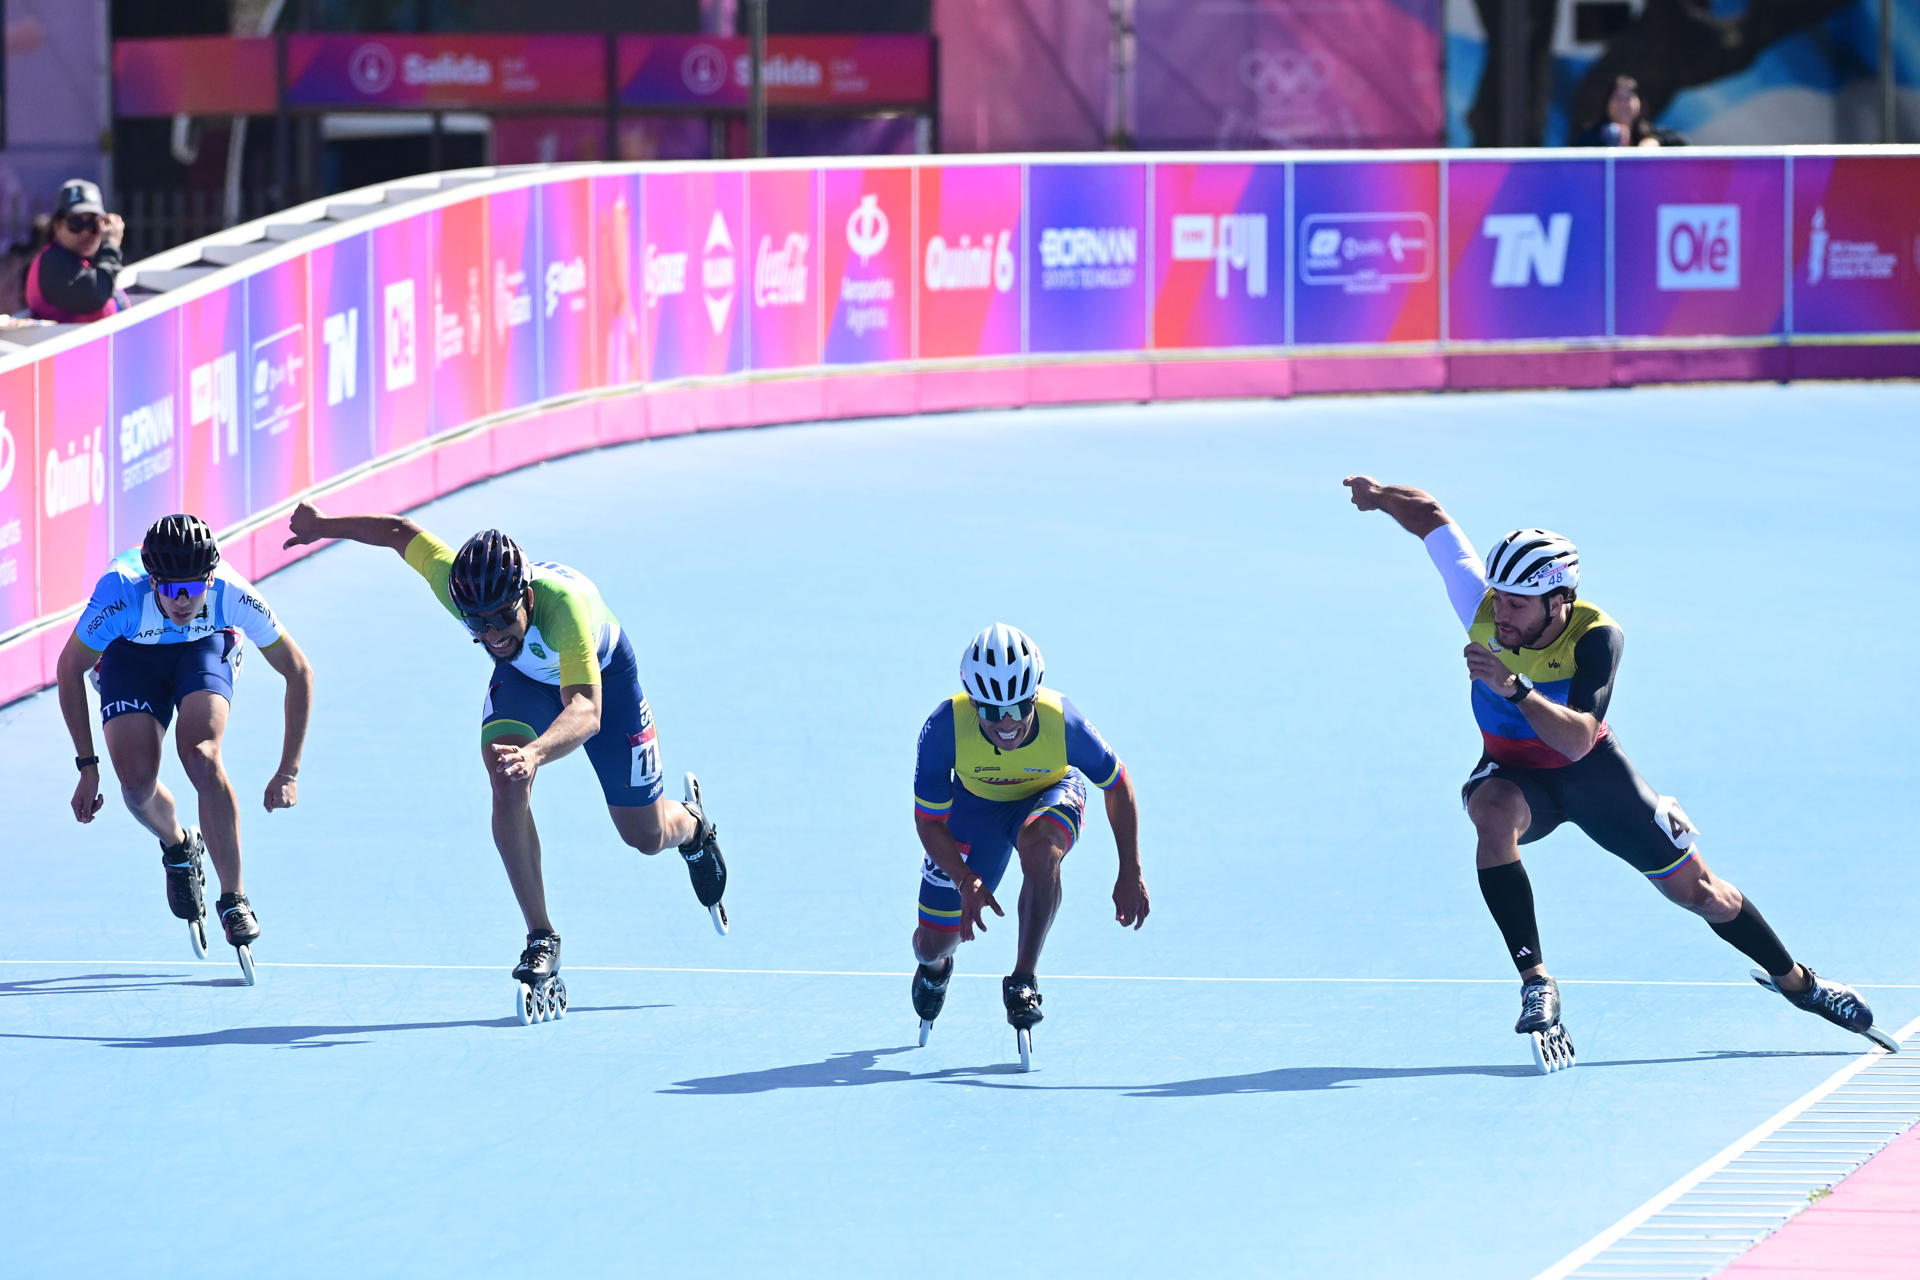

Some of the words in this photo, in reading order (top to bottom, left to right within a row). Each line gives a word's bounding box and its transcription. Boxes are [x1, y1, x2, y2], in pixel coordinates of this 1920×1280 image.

[403, 53, 491, 85] Salida
[925, 235, 993, 292] Quini
[994, 229, 1015, 293] 6
[1483, 212, 1573, 286] TN
[1668, 219, 1730, 274] Olé
[323, 307, 358, 407] TN
[92, 425, 106, 505] 6
[1547, 572, 1563, 586] 48
[87, 599, 127, 639] ARGENTINA
[638, 745, 657, 777] 11
